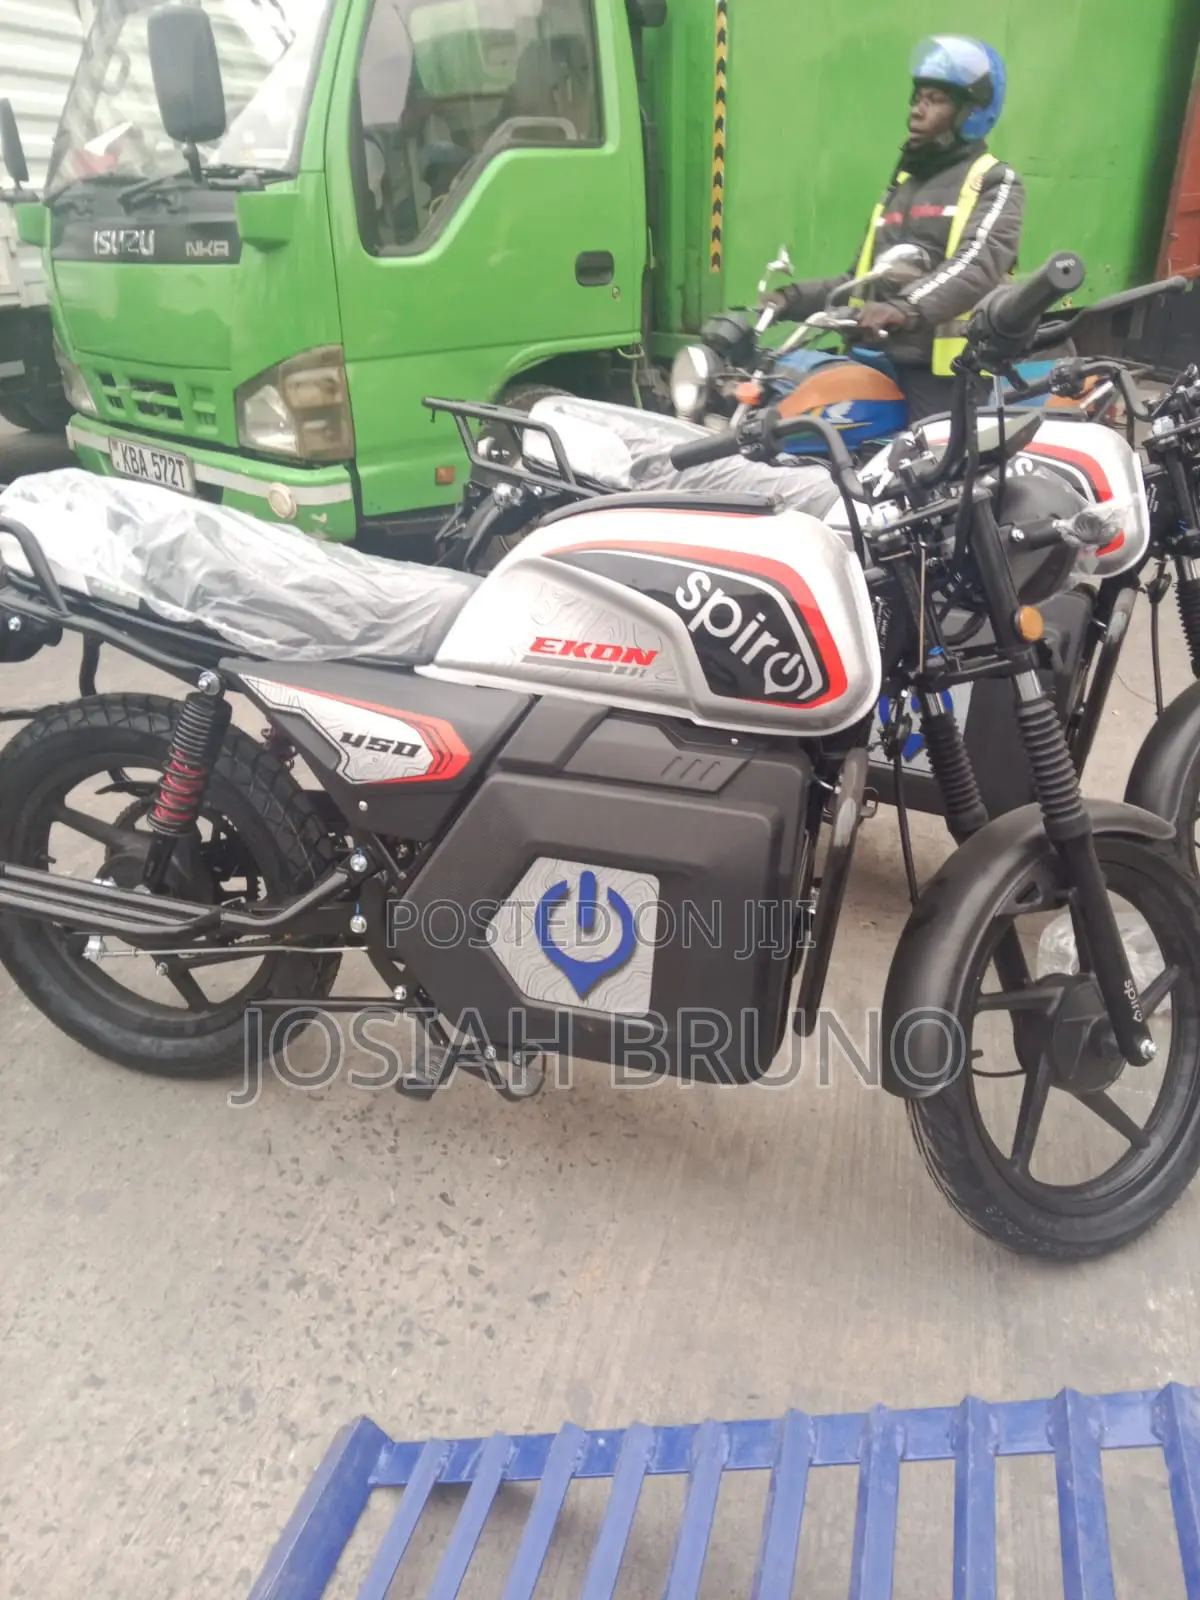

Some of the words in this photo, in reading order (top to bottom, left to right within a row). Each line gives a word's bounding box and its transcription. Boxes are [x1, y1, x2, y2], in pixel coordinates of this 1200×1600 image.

[93, 228, 155, 256] ISUZU
[185, 239, 229, 257] NKR
[121, 443, 148, 477] KBA
[151, 451, 185, 488] 572T
[675, 571, 805, 695] spiro
[529, 636, 658, 666] EKON
[340, 731, 422, 758] 450
